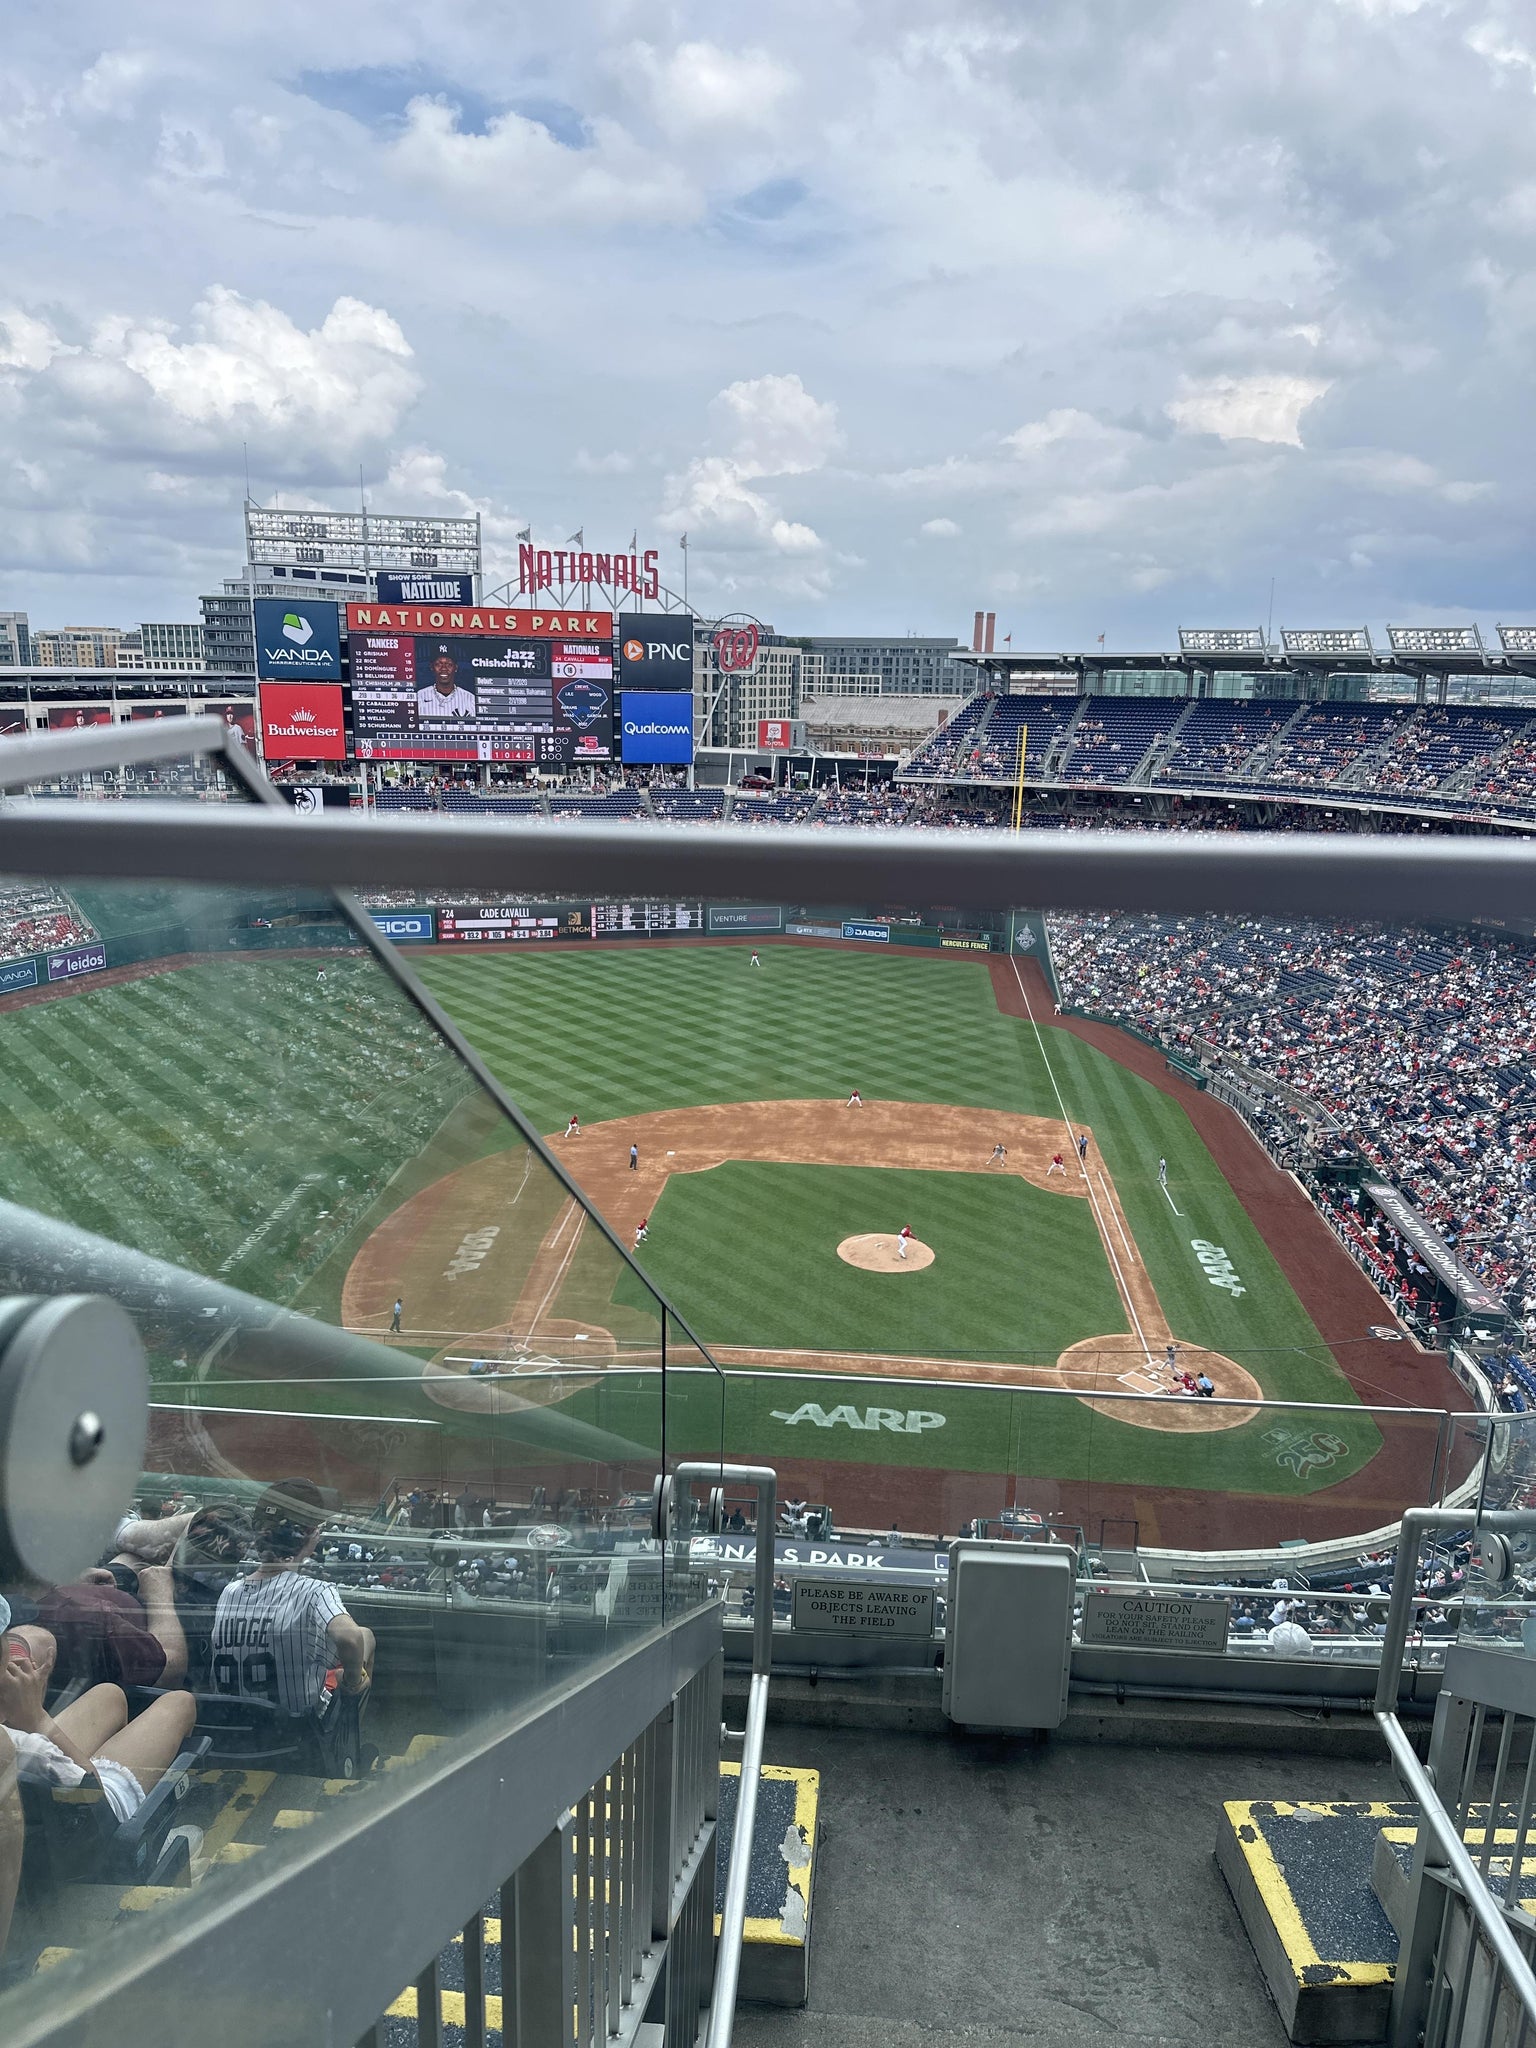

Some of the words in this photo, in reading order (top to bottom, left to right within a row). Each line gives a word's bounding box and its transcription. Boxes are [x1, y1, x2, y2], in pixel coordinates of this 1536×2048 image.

[519, 544, 658, 599] NATIONALS
[401, 581, 461, 599] NATITUDE
[357, 609, 518, 631] NATIONALS
[532, 615, 599, 633] PARK
[366, 638, 399, 649] YANKEES
[563, 645, 600, 656] NATIONALS
[265, 648, 333, 662] VANDA
[504, 648, 535, 660] Jazz
[646, 643, 690, 661] PNC
[471, 658, 520, 668] Chisholm
[522, 660, 535, 669] Jr.
[267, 724, 338, 737] Budweiser
[624, 721, 690, 735] Qualcomm
[480, 908, 499, 919] CADE
[500, 908, 530, 918] CAVALLI
[376, 920, 422, 933] EICO
[854, 929, 887, 938] DABOS
[467, 931, 480, 939] 93.2
[942, 939, 969, 948] HERCULES
[970, 941, 988, 950] FENCE
[67, 954, 104, 972] leidos
[0, 968, 33, 982] VANDA
[1384, 1198, 1430, 1238] NATIONALS
[1190, 1239, 1247, 1297] AARP
[1418, 1238, 1478, 1293] WASHINGTON
[769, 1402, 947, 1434] AARP
[810, 1550, 885, 1568] PARK
[1278, 1581, 1288, 1589] 22
[800, 1588, 845, 1600] PLEASE
[848, 1591, 863, 1600] BE
[869, 1592, 908, 1603] AWARE
[912, 1595, 928, 1604] OF
[811, 1602, 863, 1613] OBJECTS
[867, 1605, 917, 1616] LEAVING
[1123, 1601, 1193, 1615] CAUTION
[832, 1615, 856, 1625] THE
[860, 1617, 895, 1627] FIELD
[1105, 1618, 1120, 1626] DO
[1121, 1620, 1141, 1628] NOT
[1142, 1621, 1158, 1629] SIT,
[1161, 1622, 1191, 1631] STAND
[1193, 1624, 1207, 1632] OR
[1118, 1613, 1144, 1621] YOUR
[1145, 1615, 1180, 1624] SAFETY
[1181, 1617, 1216, 1625] PLEASE
[214, 1617, 273, 1649] JUDGE
[1091, 1633, 1128, 1641] VIOLATORS
[1143, 1636, 1174, 1644] SUBJECT
[1147, 1628, 1166, 1636] THE
[1168, 1630, 1204, 1639] RAILING
